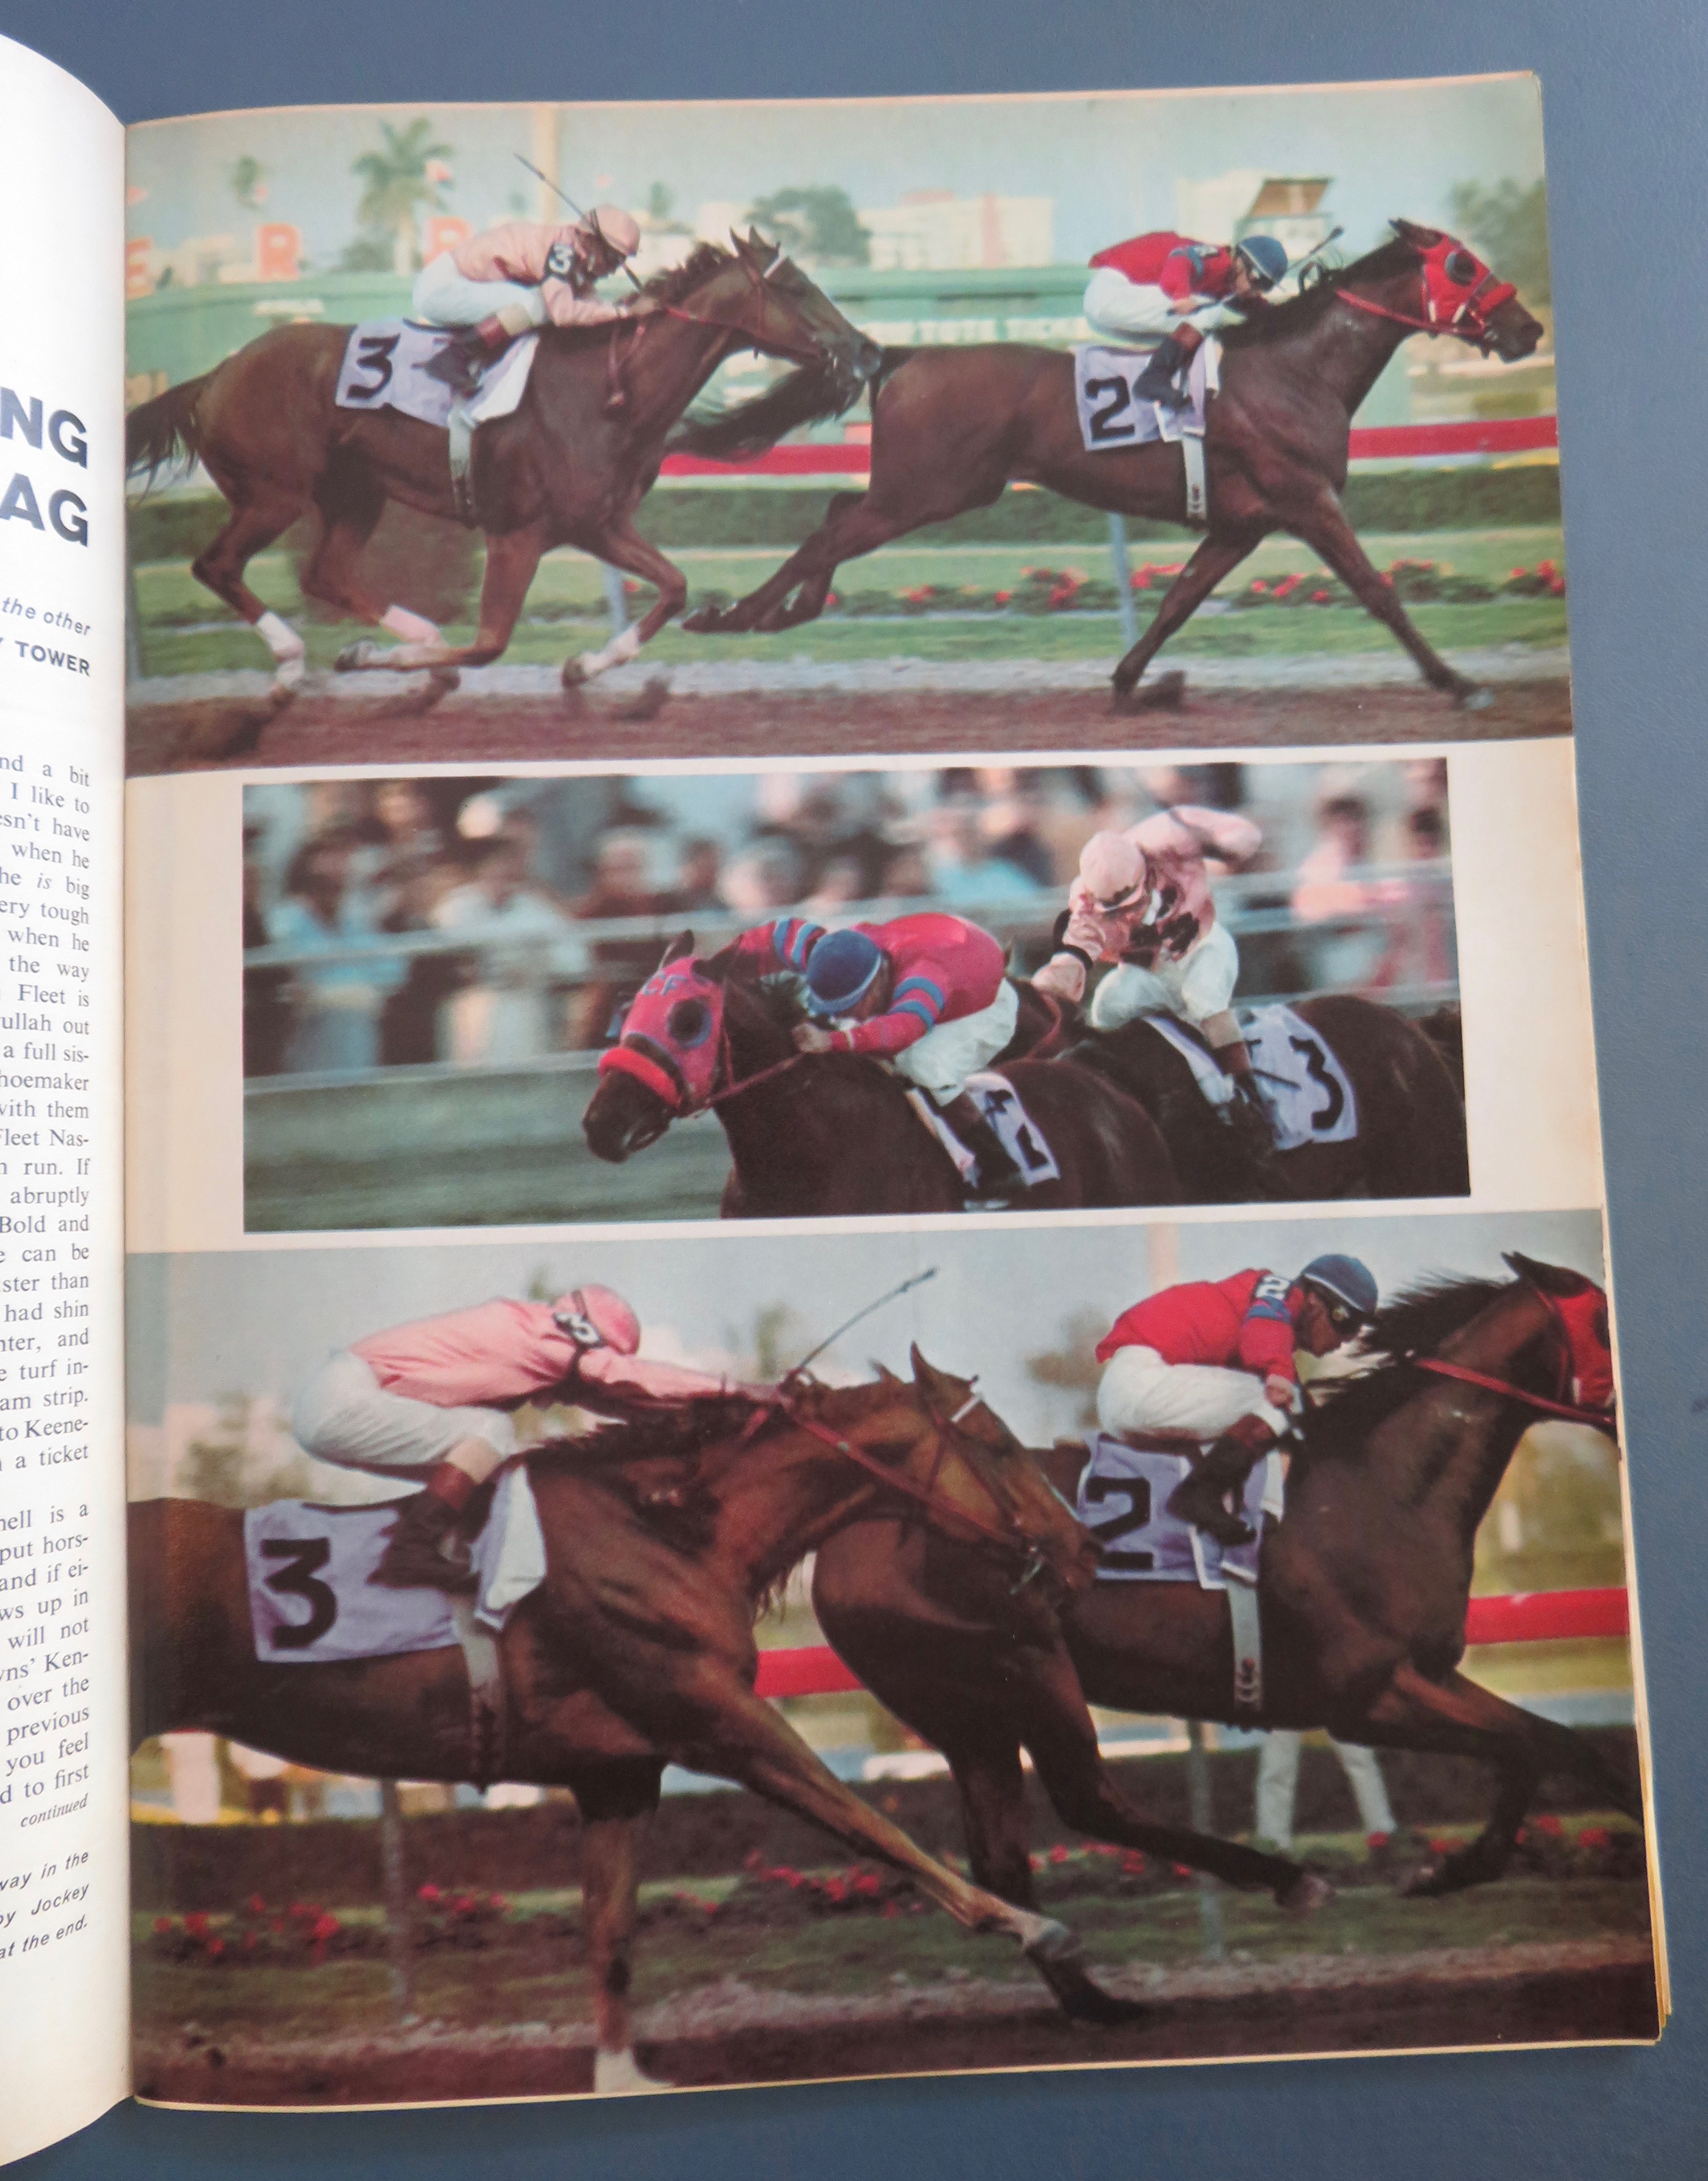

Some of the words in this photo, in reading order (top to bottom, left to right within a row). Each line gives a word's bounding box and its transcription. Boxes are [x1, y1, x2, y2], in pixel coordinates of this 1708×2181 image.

[549, 241, 574, 275] 3
[345, 333, 401, 401] 3
[1085, 375, 1135, 443] 2
[0, 386, 88, 469] NG
[0, 473, 88, 547] AG
[2, 597, 36, 619] the
[43, 612, 91, 636] other
[14, 640, 90, 677] TOWER
[0, 755, 24, 772] nd
[42, 764, 52, 777] a
[69, 765, 90, 787] bit
[11, 782, 18, 799] I
[32, 785, 65, 808] like
[74, 798, 90, 814] to
[0, 813, 40, 832] sn't
[53, 818, 90, 841] have
[11, 842, 62, 863] when
[72, 849, 90, 869] he
[37, 873, 52, 889] is
[66, 876, 90, 900] big
[0, 900, 30, 919] ery
[41, 903, 89, 926] tough
[7, 927, 59, 947] when
[72, 933, 90, 952] he
[8, 955, 40, 973] the
[56, 963, 89, 983] way
[17, 984, 65, 1004] Fleet
[78, 990, 90, 1007] is
[1, 1012, 52, 1032] ullah
[63, 1021, 90, 1035] out
[3, 1045, 15, 1058] a
[23, 1041, 56, 1060] full
[63, 1045, 89, 1062] sis-
[1288, 1034, 1345, 1132] 3
[47, 1101, 89, 1119] them
[0, 1128, 40, 1146] leet
[49, 1129, 89, 1147] Nas-
[23, 1163, 62, 1175] run.
[77, 1158, 91, 1175] If
[10, 1186, 89, 1207] abruptly
[0, 1215, 46, 1233] Bold
[58, 1214, 89, 1232] and
[21, 1249, 56, 1262] can
[71, 1243, 89, 1260] be
[51, 1272, 89, 1290] than
[1255, 1276, 1291, 1300] 2
[4, 1302, 43, 1322] had
[54, 1300, 89, 1319] shin
[57, 1327, 89, 1347] and
[555, 1312, 600, 1343] 3
[19, 1359, 58, 1380] turf
[67, 1358, 89, 1376] in-
[0, 1396, 31, 1411] am
[43, 1387, 88, 1407] strip.
[24, 1419, 89, 1438] Keene-
[15, 1456, 27, 1469] a
[39, 1444, 89, 1466] ticket
[50, 1506, 64, 1524] is
[79, 1504, 89, 1517] a
[1086, 1475, 1154, 1571] 2
[0, 1541, 34, 1566] put
[42, 1534, 89, 1554] hors-
[0, 1568, 37, 1592] and
[47, 1563, 62, 1583] if
[68, 1558, 89, 1578] ei-
[37, 1597, 62, 1616] up
[73, 1588, 88, 1607] in
[260, 1537, 337, 1652] 3
[7, 1625, 45, 1650] will
[60, 1617, 89, 1639] not
[0, 1658, 35, 1682] ns'
[43, 1651, 89, 1673] Ken-
[7, 1688, 53, 1711] over
[62, 1677, 89, 1698] the
[6, 1707, 90, 1747] previous
[6, 1751, 45, 1777] you
[58, 1732, 89, 1759] feel
[24, 1782, 45, 1798] to
[54, 1764, 89, 1789] first
[20, 1792, 89, 1828] continued
[41, 1863, 57, 1879] in
[65, 1852, 89, 1870] the
[31, 1884, 89, 1916] Jockey
[22, 1933, 50, 1953] the
[55, 1914, 88, 1940] end.
